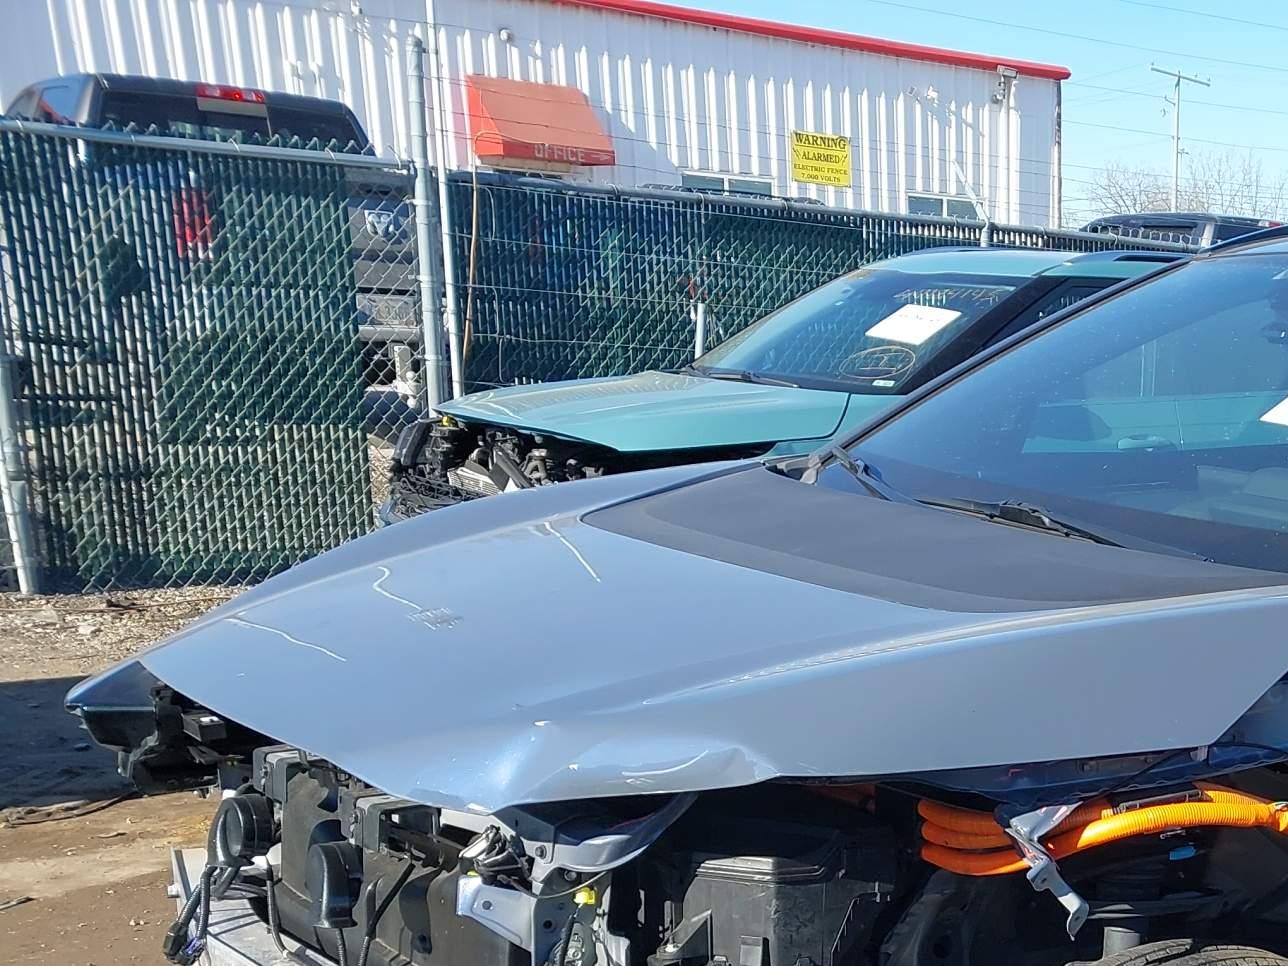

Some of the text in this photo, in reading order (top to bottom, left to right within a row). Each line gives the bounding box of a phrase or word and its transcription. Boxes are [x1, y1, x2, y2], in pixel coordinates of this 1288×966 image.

[794, 132, 846, 149] WARNING
[534, 144, 585, 162] OFFICE
[801, 150, 840, 164] ALARMED
[793, 163, 849, 175] ELECTRIC FENCE
